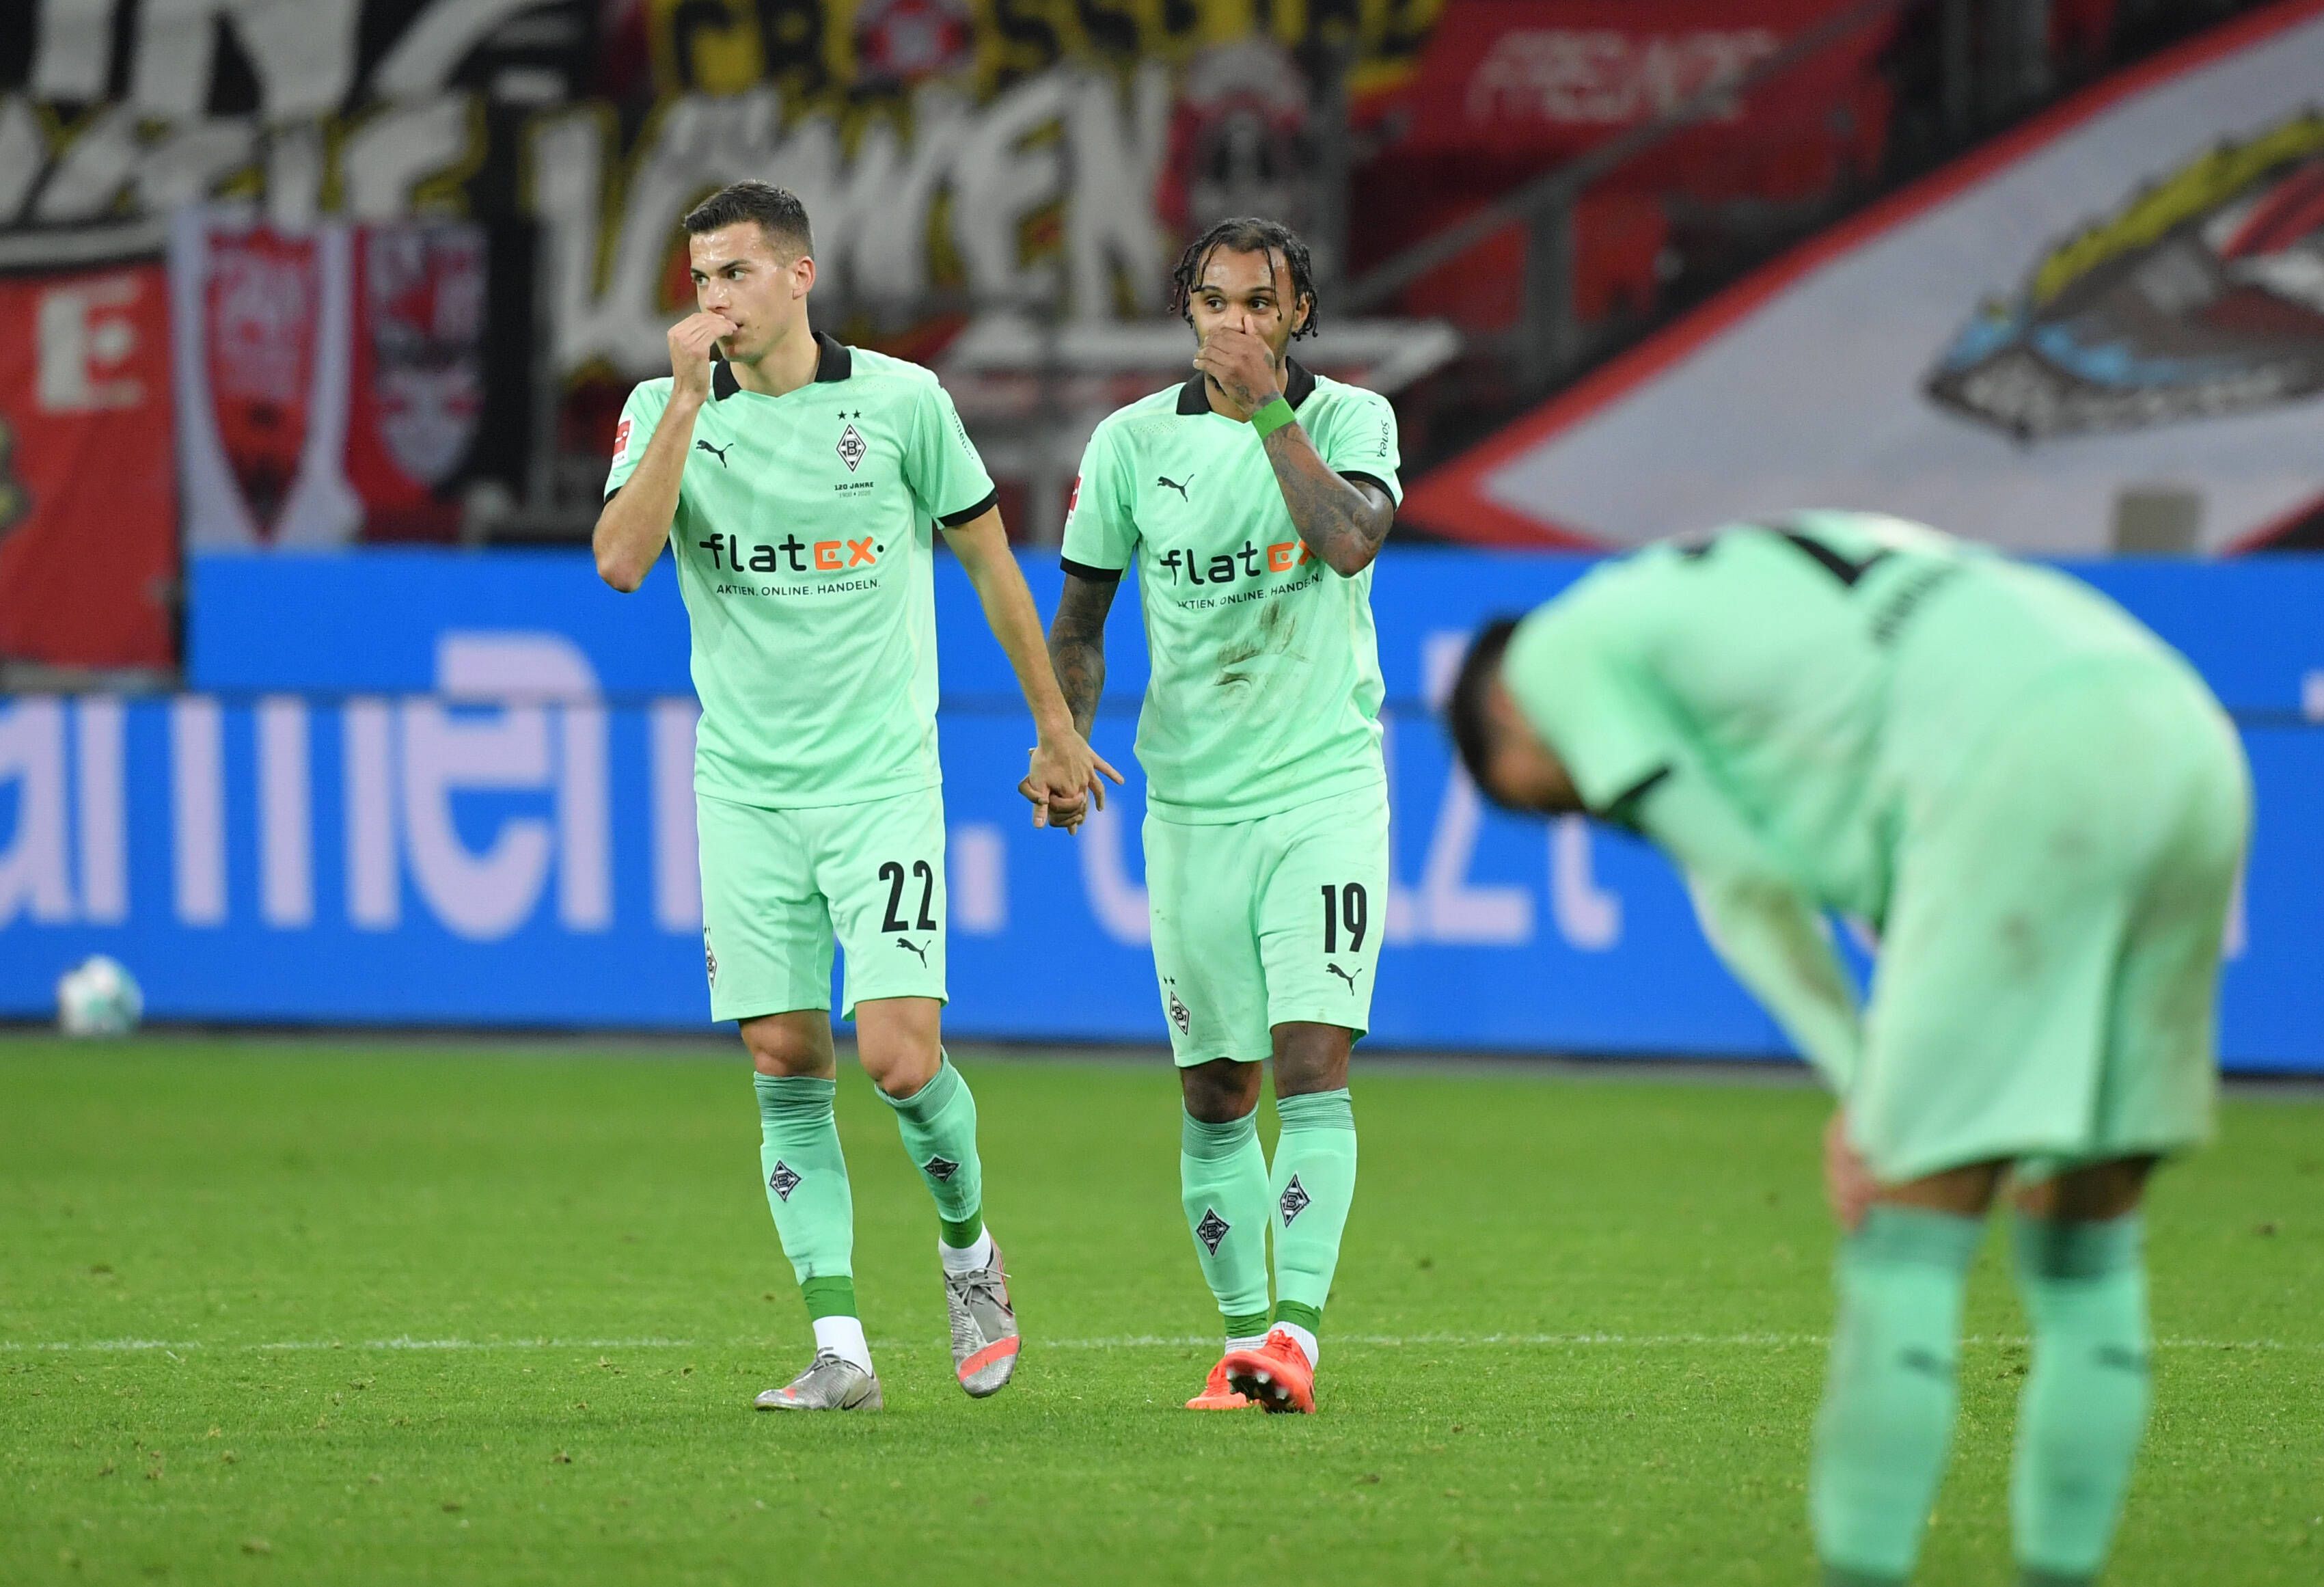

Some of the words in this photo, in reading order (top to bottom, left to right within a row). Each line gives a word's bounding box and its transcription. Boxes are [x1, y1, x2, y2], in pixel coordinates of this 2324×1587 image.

[849, 481, 874, 489] JAHRE
[717, 584, 758, 597] AKTIEN.
[761, 586, 813, 596] ONLINE.
[817, 579, 881, 595] HANDELN.
[1220, 589, 1267, 605] ONLINE.
[879, 860, 937, 933] 22
[1322, 882, 1367, 953] 19
